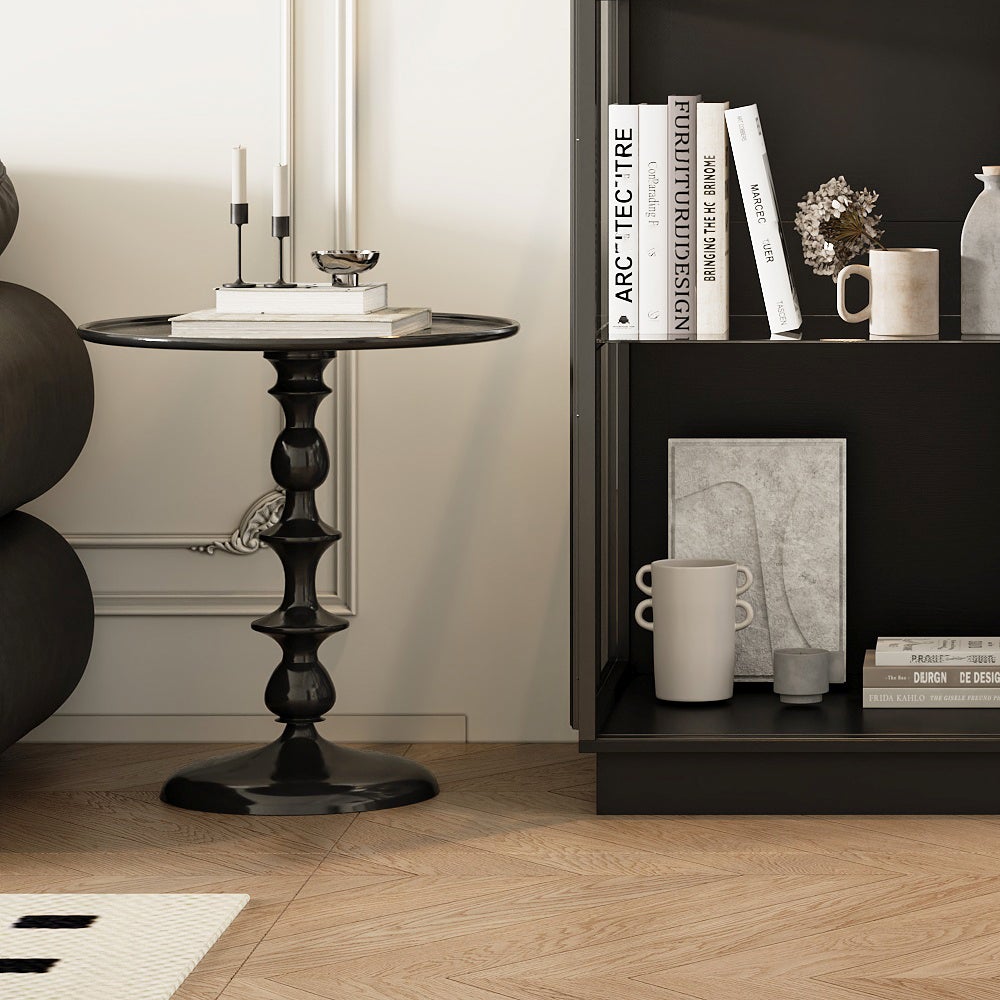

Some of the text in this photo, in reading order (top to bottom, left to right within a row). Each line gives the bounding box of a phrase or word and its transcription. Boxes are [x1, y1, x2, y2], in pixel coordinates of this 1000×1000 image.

[703, 216, 716, 234] THE
[703, 238, 716, 282] BRINGING
[868, 694, 894, 702] FRIDA
[896, 694, 926, 702] KAHLO
